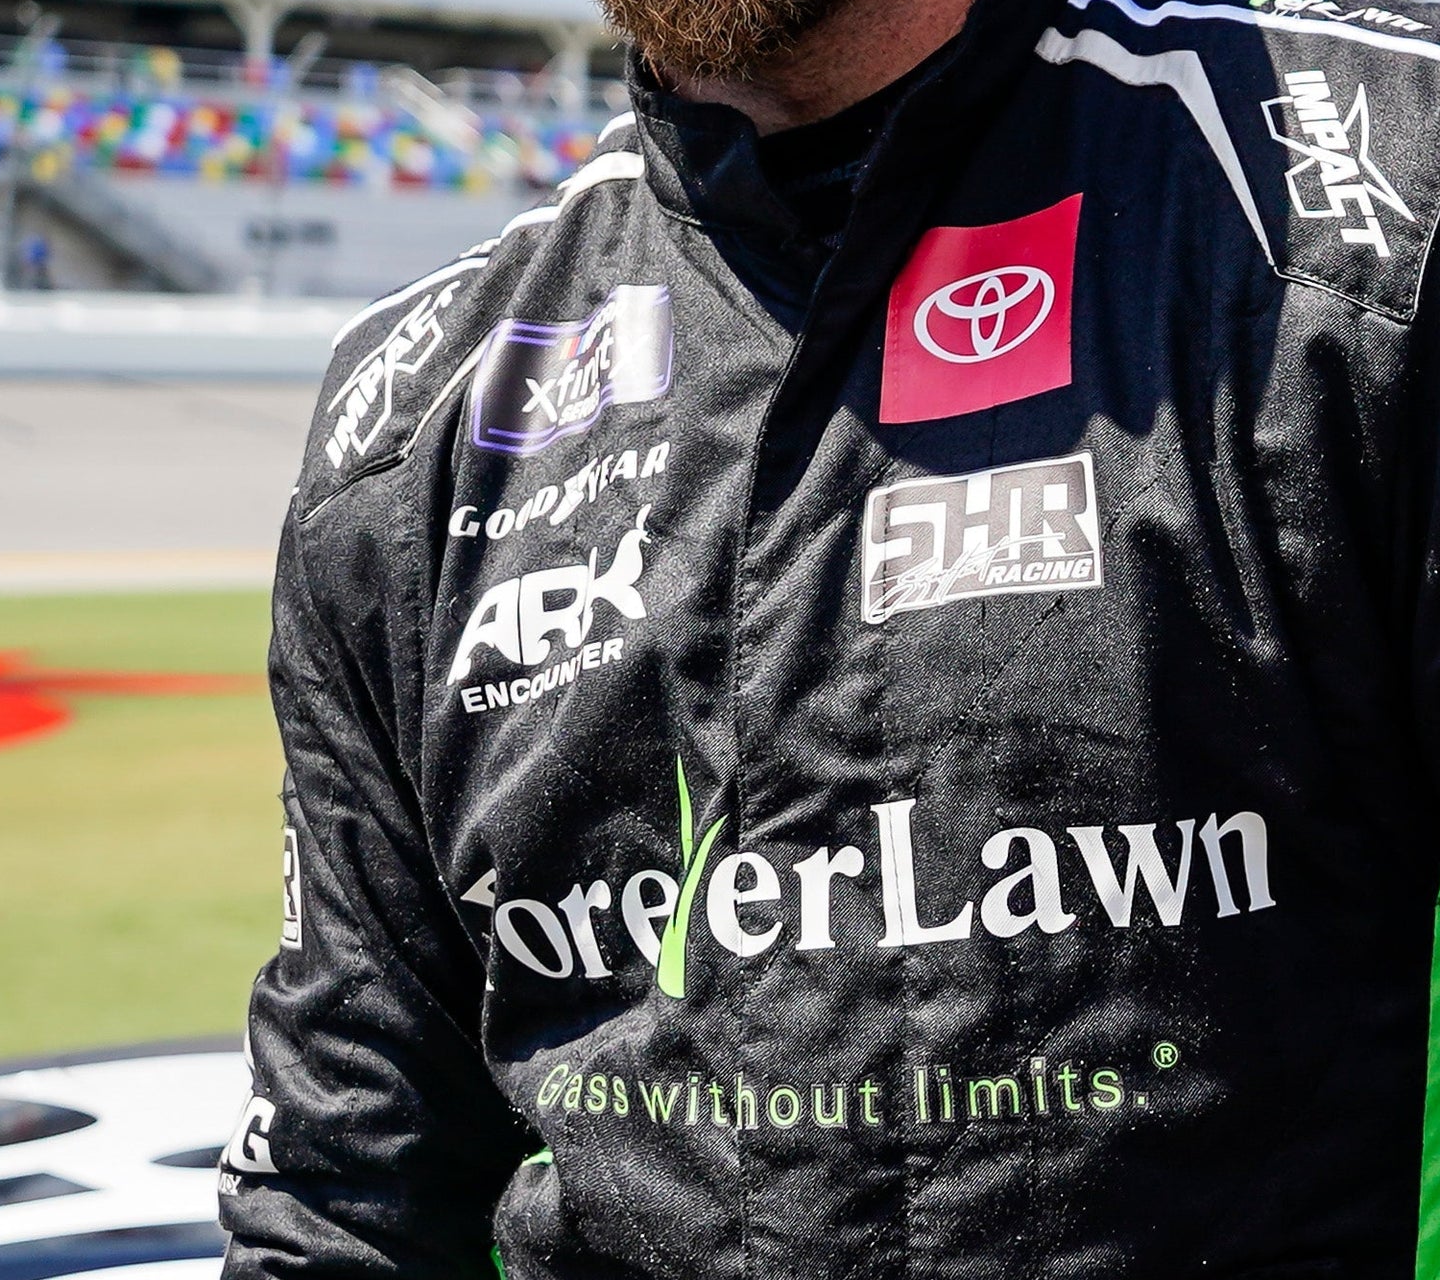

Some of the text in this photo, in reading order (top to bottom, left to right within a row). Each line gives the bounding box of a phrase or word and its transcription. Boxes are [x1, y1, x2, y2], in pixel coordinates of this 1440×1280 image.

[1283, 70, 1391, 258] IMPACT
[985, 557, 1094, 587] RACING
[640, 1071, 879, 1128] without
